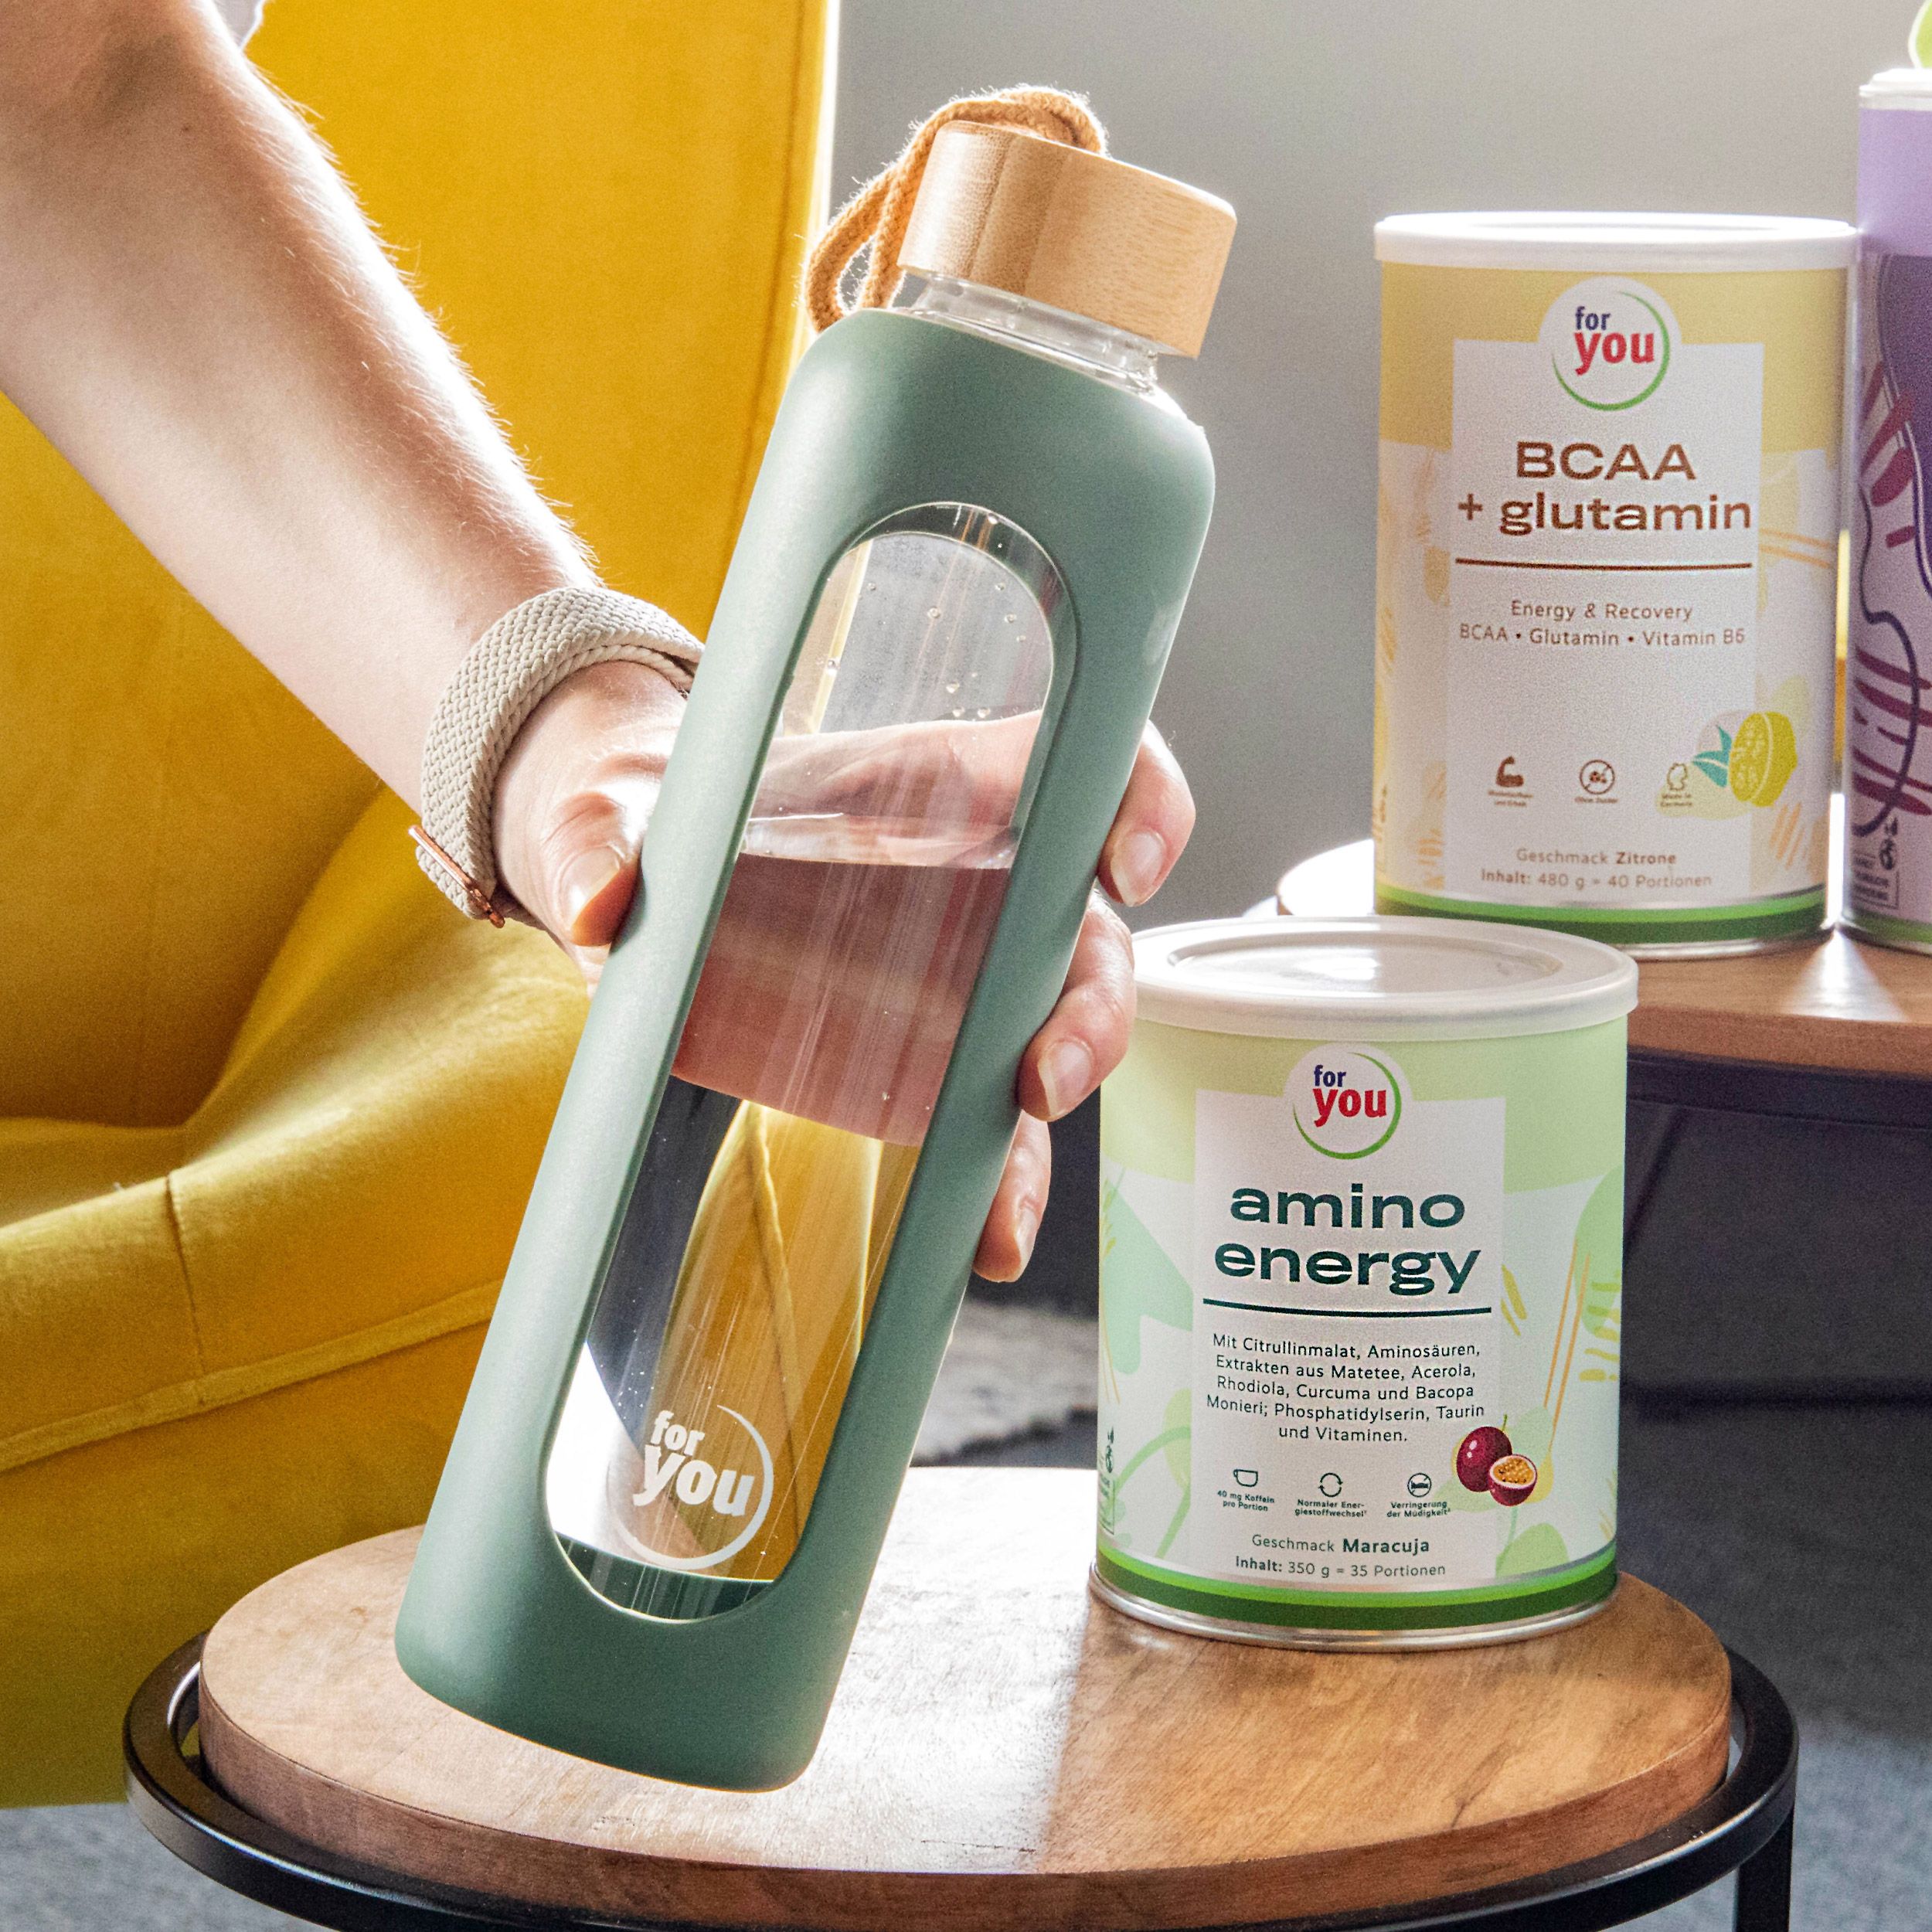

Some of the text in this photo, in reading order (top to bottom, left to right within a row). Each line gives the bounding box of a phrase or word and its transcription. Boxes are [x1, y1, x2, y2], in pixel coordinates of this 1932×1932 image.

[1574, 305, 1611, 331] for
[1573, 332, 1655, 376] you
[1515, 440, 1696, 481] BCAA
[1499, 491, 1752, 536] glutamin
[1511, 600, 1692, 621] Energy & Recovery
[1459, 624, 1508, 641] BCAA
[1529, 628, 1620, 646] Glutamin
[1641, 630, 1716, 646] Vitamin
[1723, 628, 1745, 645] B6
[1515, 848, 1678, 866] Geschmack Zitrone
[1481, 869, 1531, 886] Inhalt:
[1537, 872, 1570, 886] 480
[1575, 876, 1586, 890] g
[1607, 874, 1630, 888] 40
[1634, 874, 1713, 888] Portionen
[1313, 1064, 1346, 1088] for
[1312, 1087, 1388, 1128] you
[1229, 1182, 1466, 1230] amino
[1213, 1242, 1482, 1296] energy
[1213, 1333, 1481, 1361] Mit Citrullinmalat, Aminosäuren,
[1216, 1354, 1476, 1382] Extrakten aus Matetee, Acerola,
[1217, 1375, 1475, 1401] Rhodiola, Curcuma und Bacopa
[1206, 1393, 1485, 1424] Monieri; Phosphatidylserin, Taurin
[650, 1409, 706, 1456] for
[1278, 1425, 1408, 1442] und Vitaminen.
[631, 1444, 755, 1517] you
[1217, 1489, 1275, 1504] 40 mg Koffein
[1223, 1500, 1269, 1512] pro Portion
[1297, 1498, 1366, 1509] Normaler Ener-
[1390, 1500, 1447, 1510] Verringerung
[1386, 1509, 1401, 1518] der
[1251, 1533, 1430, 1556] Geschmack Maracuja
[1236, 1555, 1283, 1573] Inhalt:
[1287, 1561, 1315, 1575] 350
[1321, 1566, 1331, 1579] g
[1349, 1564, 1369, 1577] 35
[1373, 1563, 1447, 1577] Portionen
